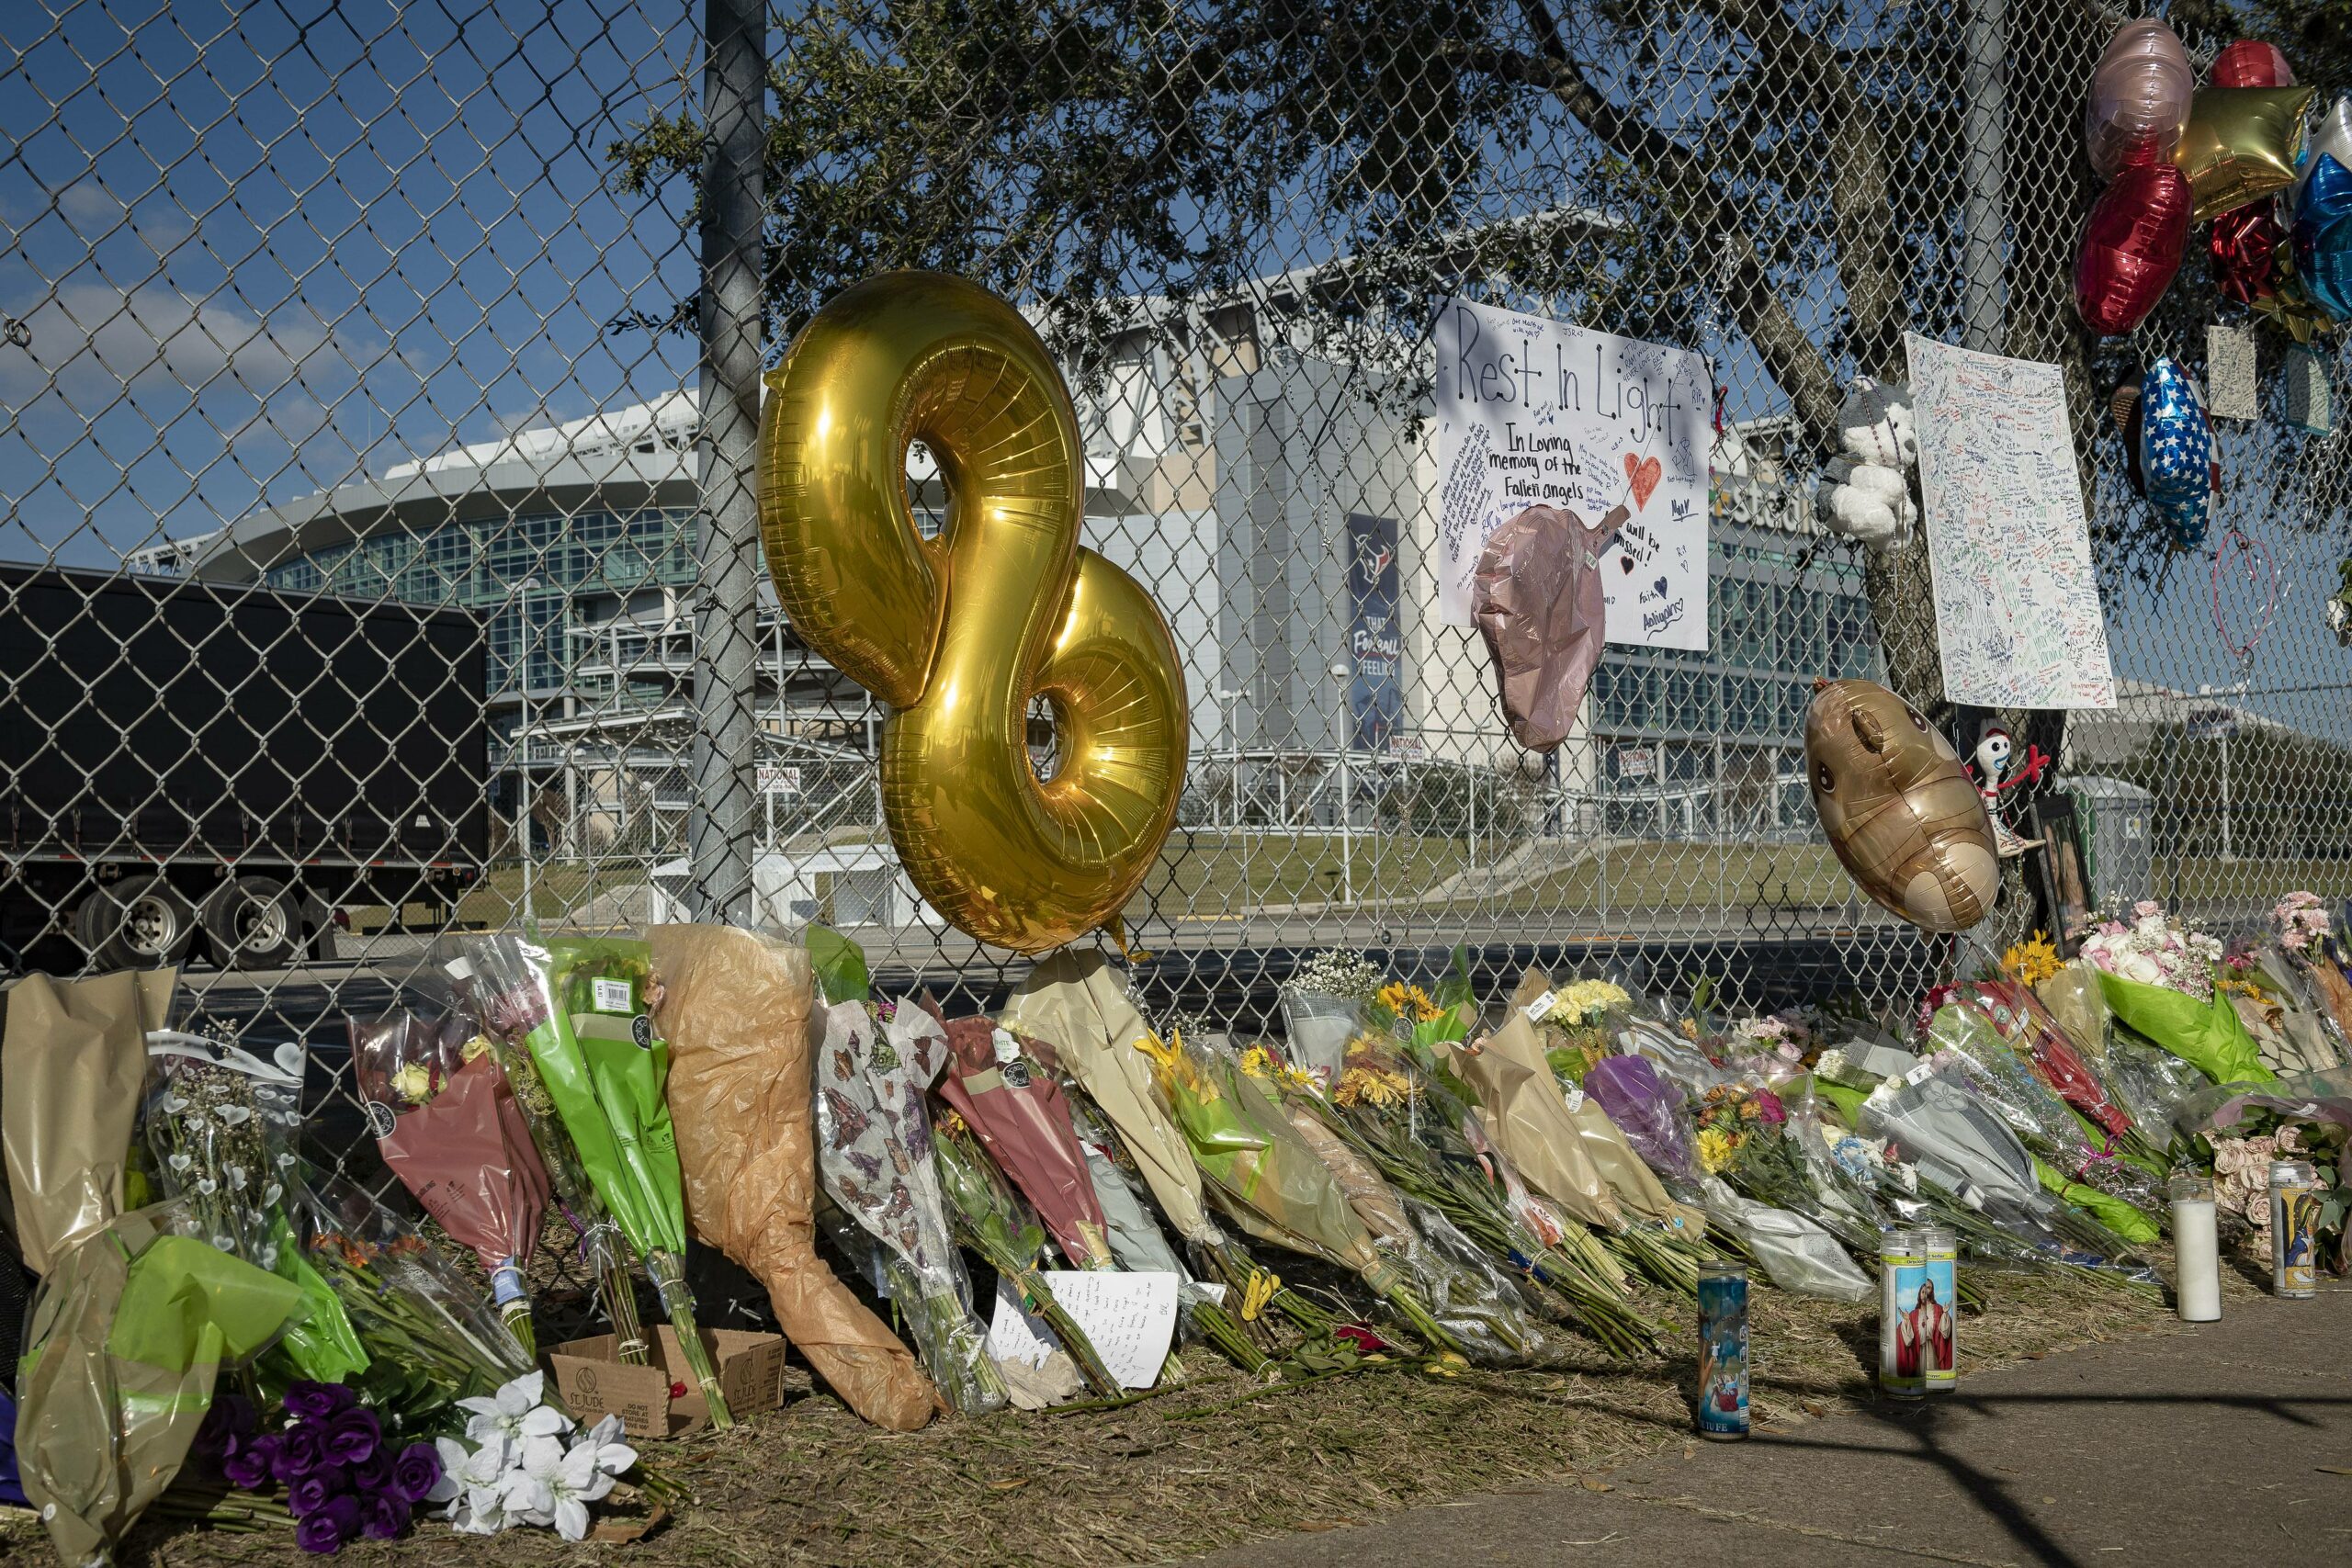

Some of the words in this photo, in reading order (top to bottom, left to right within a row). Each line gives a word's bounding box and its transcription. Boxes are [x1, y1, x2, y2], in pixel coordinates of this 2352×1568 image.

[1639, 353, 1651, 369] LOVE
[1456, 305, 1543, 409] Rest
[1556, 343, 1581, 412] In
[1597, 343, 1681, 447] Light
[1506, 423, 1524, 452] In
[1529, 433, 1574, 465] Loving
[1489, 453, 1540, 479] memory
[1544, 457, 1558, 471] of
[1562, 457, 1581, 475] the
[1543, 481, 1583, 506] angels
[1626, 522, 1645, 540] will
[1648, 532, 1660, 553] be
[582, 1394, 604, 1409] JUDE
[1715, 1423, 1727, 1431] FE
